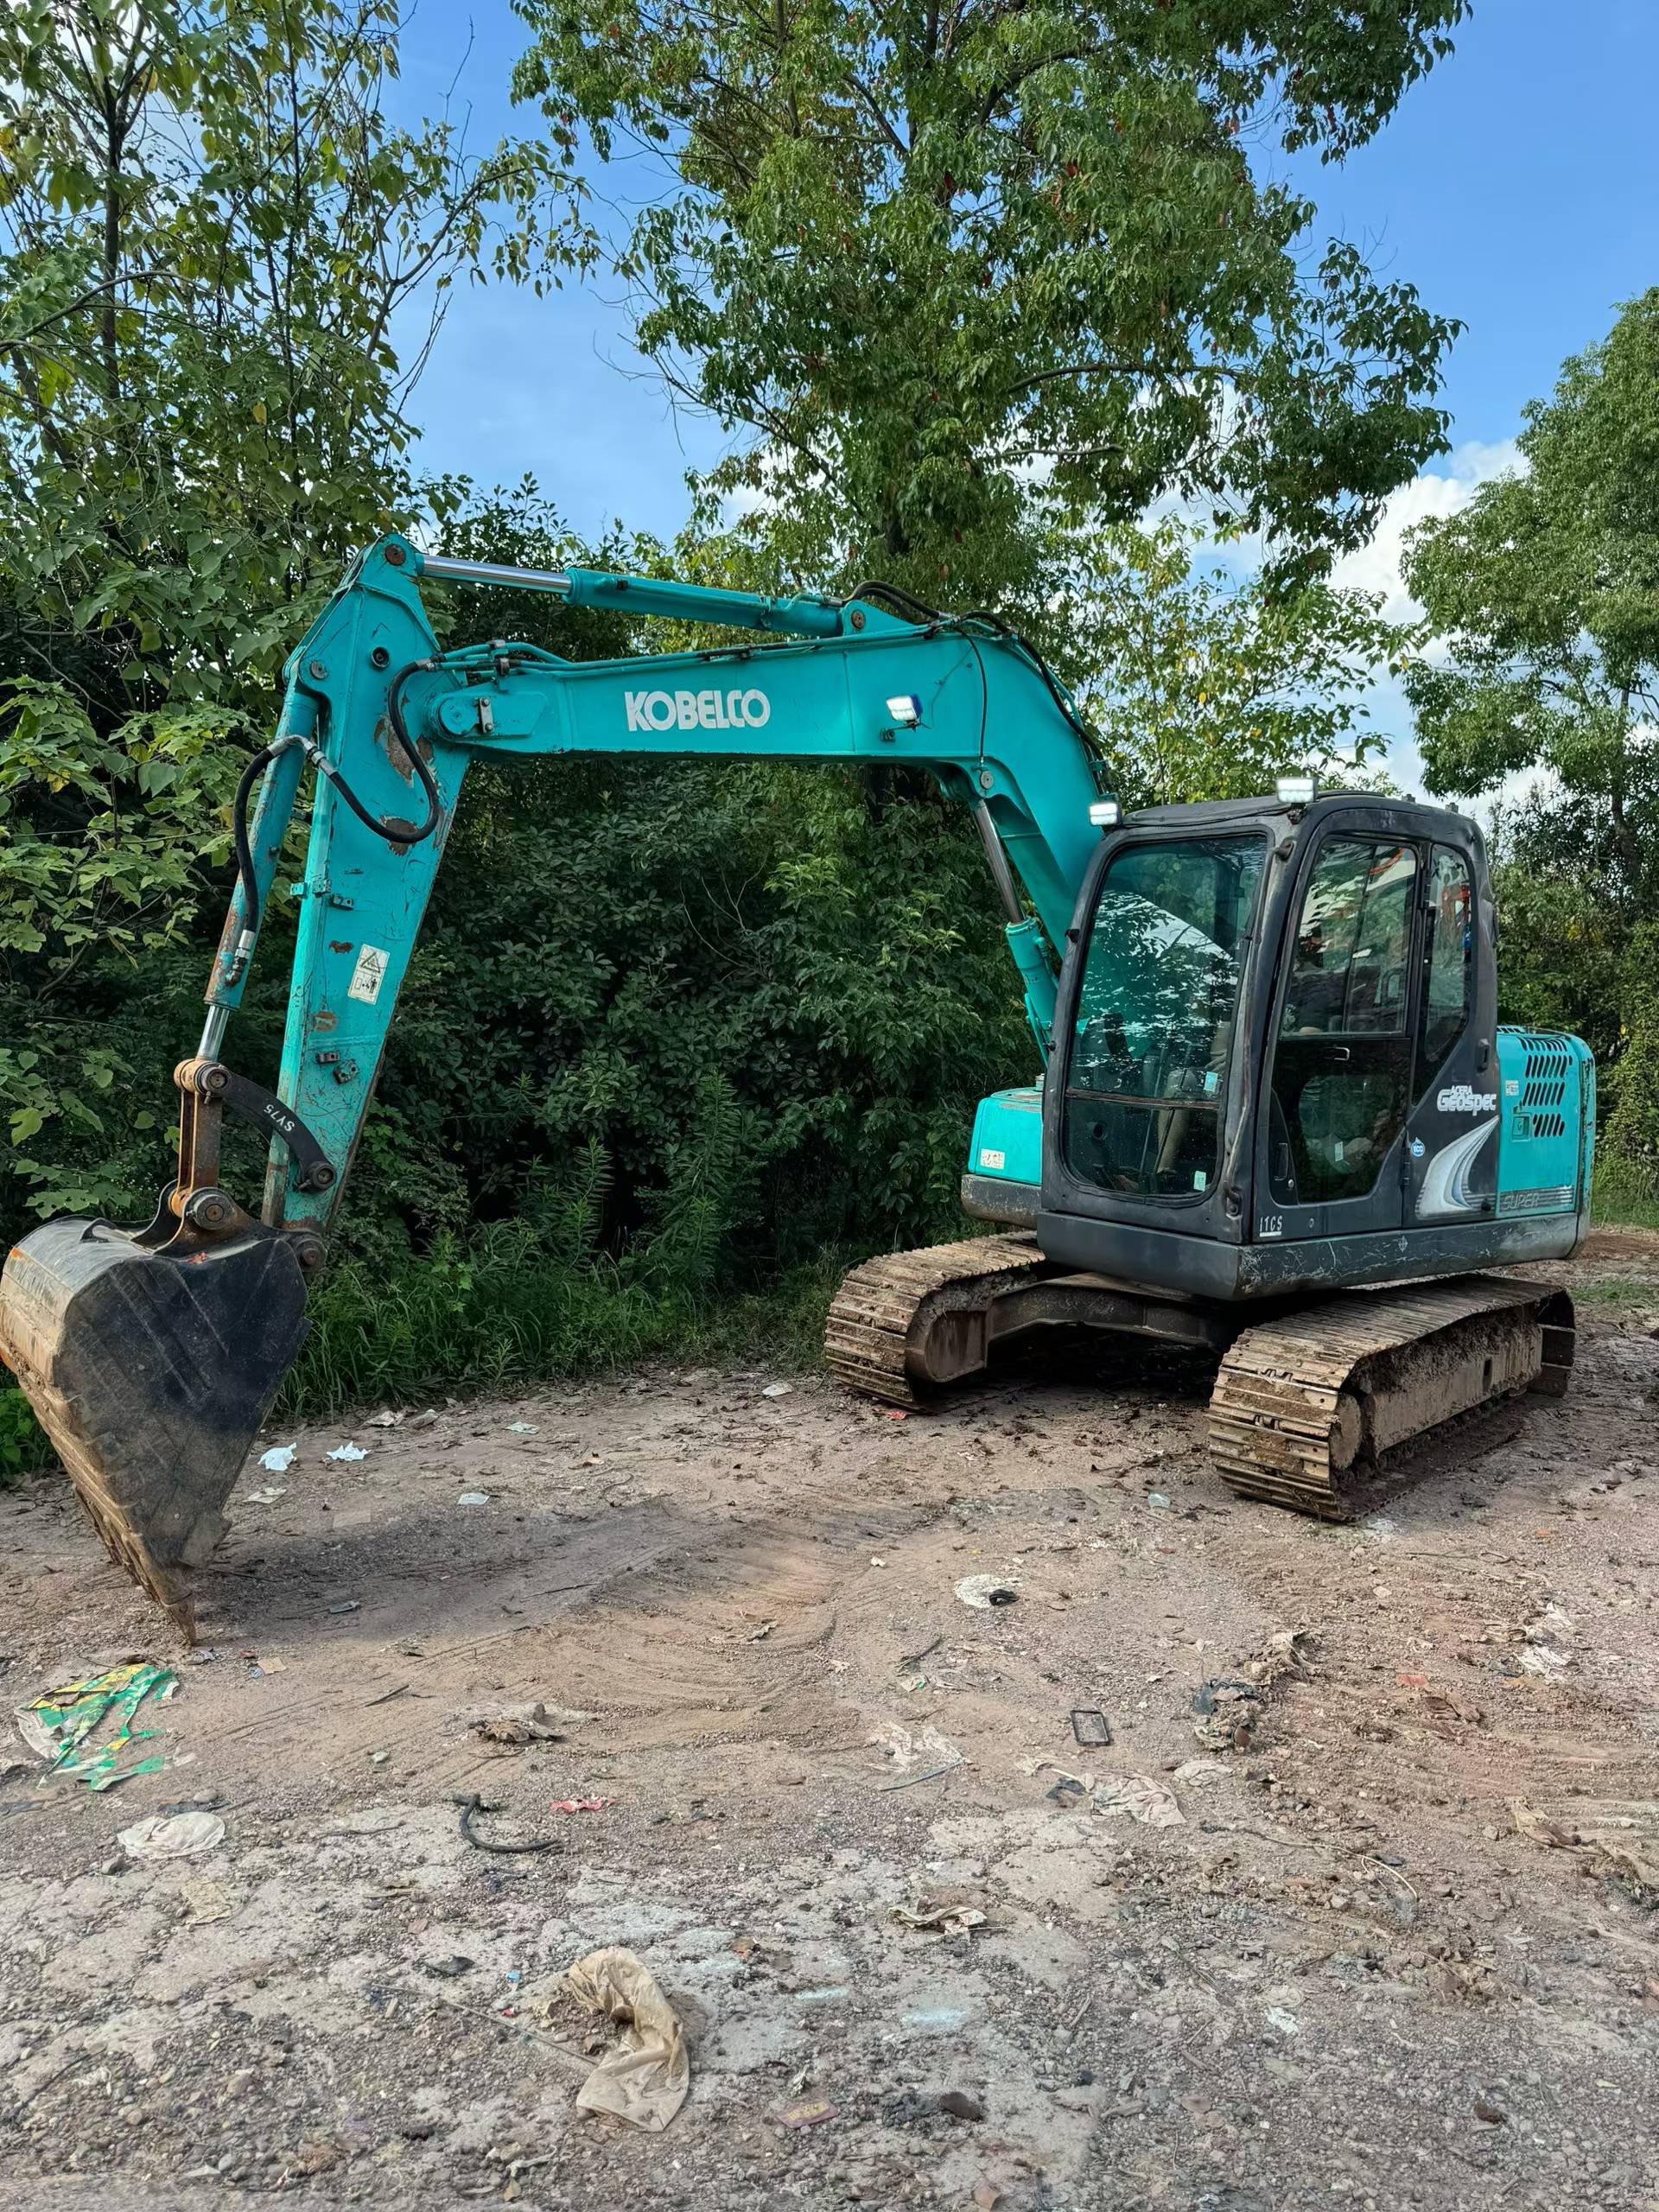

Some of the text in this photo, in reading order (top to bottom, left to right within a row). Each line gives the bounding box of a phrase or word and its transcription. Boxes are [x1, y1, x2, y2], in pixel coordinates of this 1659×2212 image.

[625, 689, 771, 731] KOBELCO
[264, 1104, 295, 1131] SY75
[1502, 1193, 1539, 1211] SUPER
